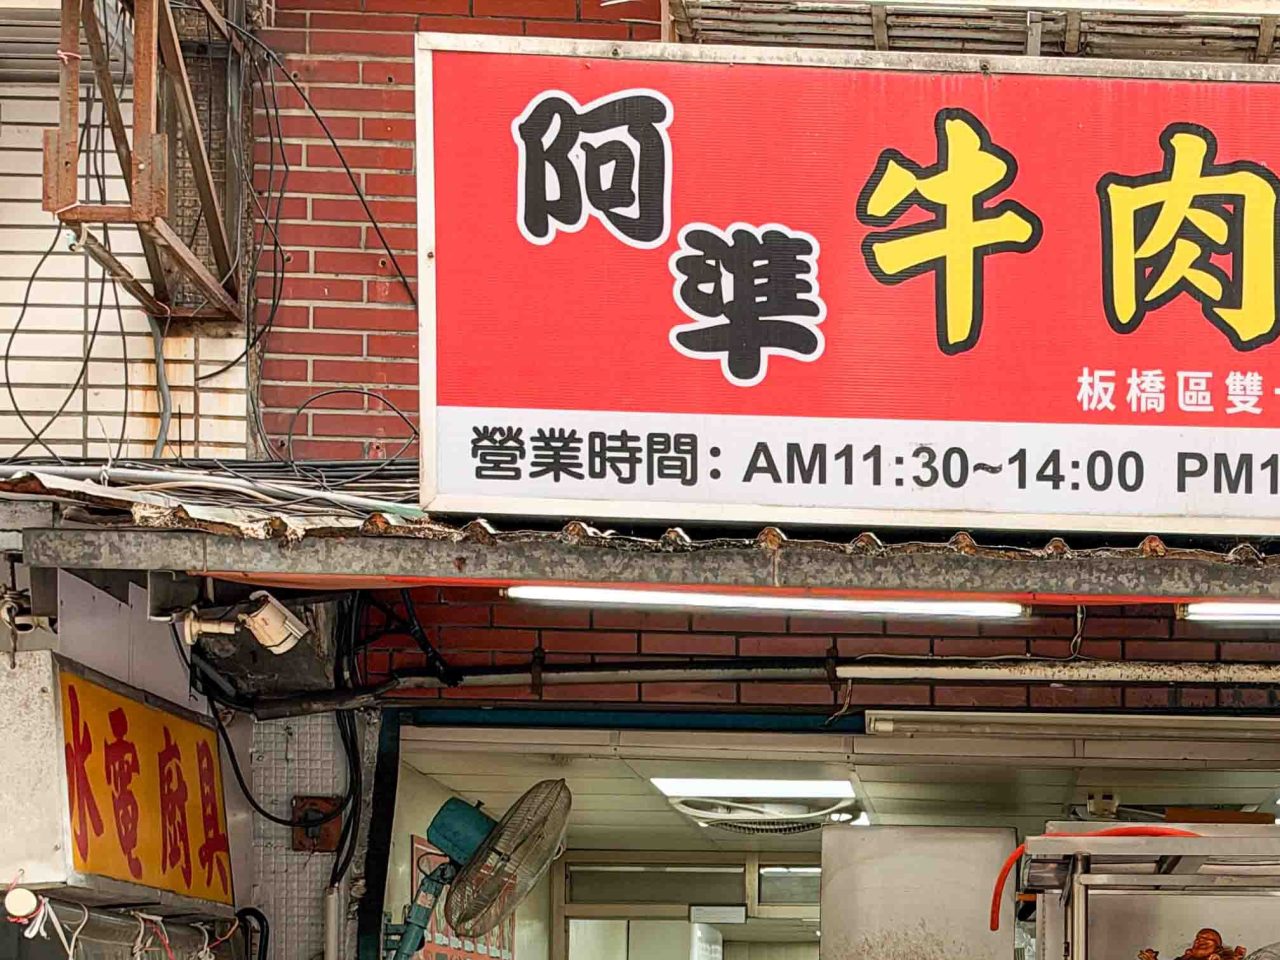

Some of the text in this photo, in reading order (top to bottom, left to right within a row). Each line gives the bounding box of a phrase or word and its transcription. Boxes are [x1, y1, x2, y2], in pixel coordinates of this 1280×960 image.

[742, 441, 1146, 494] AM11:30~14:00
[64, 684, 229, 895] 水電廚具
